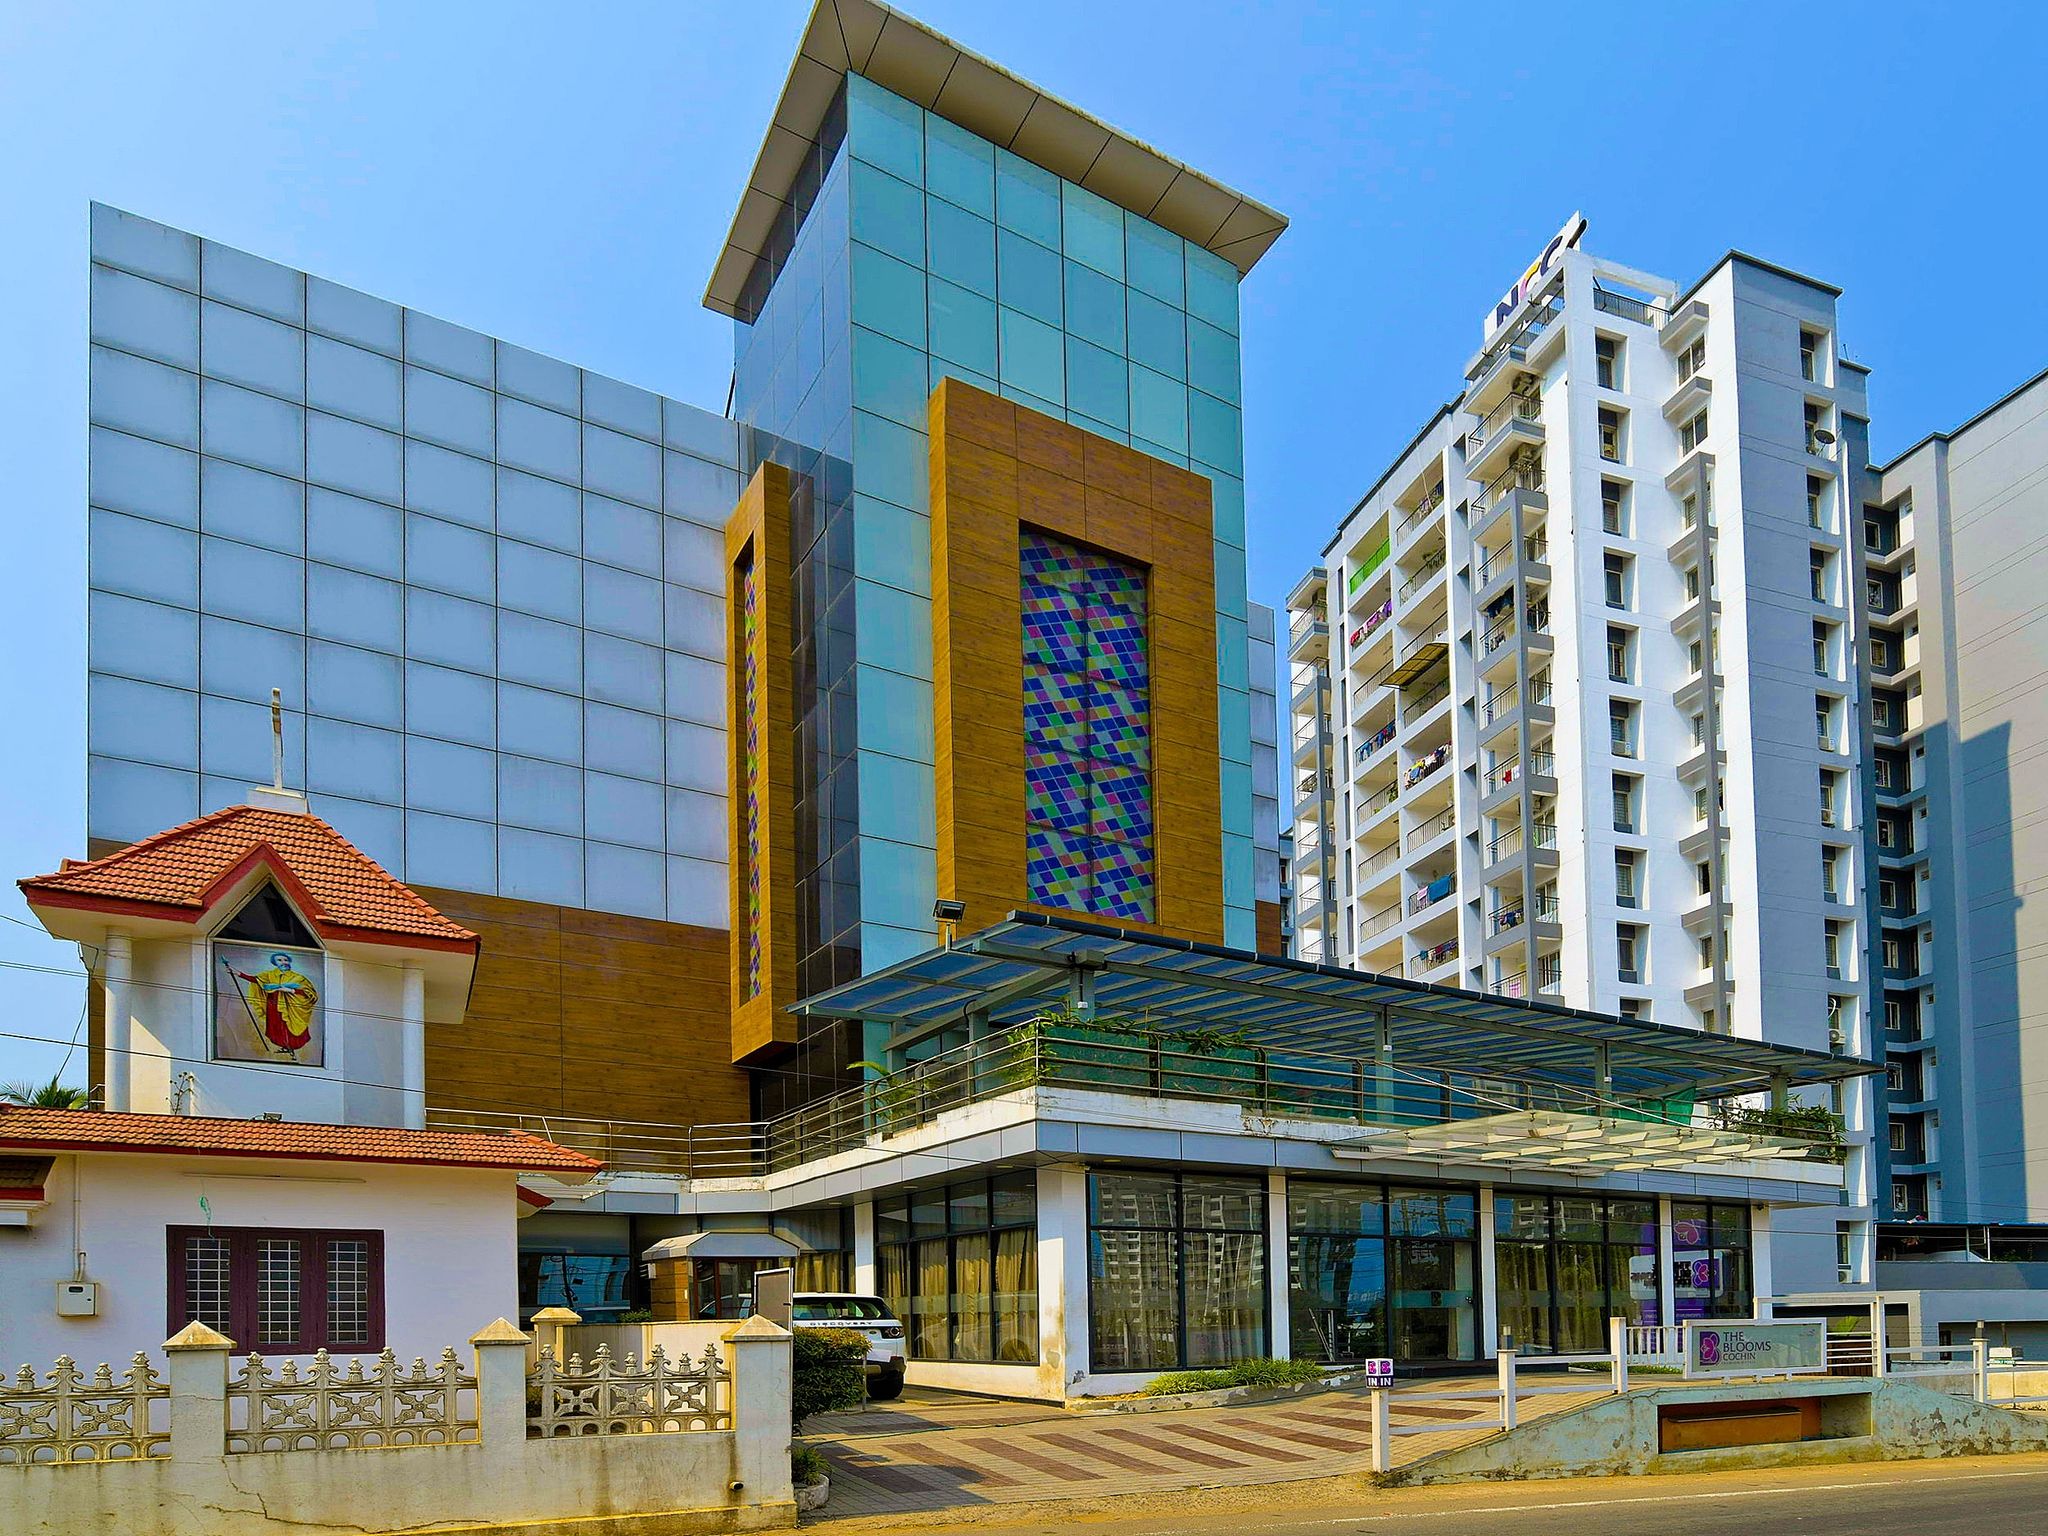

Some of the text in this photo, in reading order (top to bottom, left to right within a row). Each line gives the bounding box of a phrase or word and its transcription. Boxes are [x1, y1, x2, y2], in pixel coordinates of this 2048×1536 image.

[1723, 1331, 1745, 1342] THE
[1723, 1341, 1772, 1353] BLOOMS
[1723, 1352, 1756, 1361] COCHIN
[1368, 1378, 1377, 1386] IN
[1380, 1378, 1391, 1386] IN
